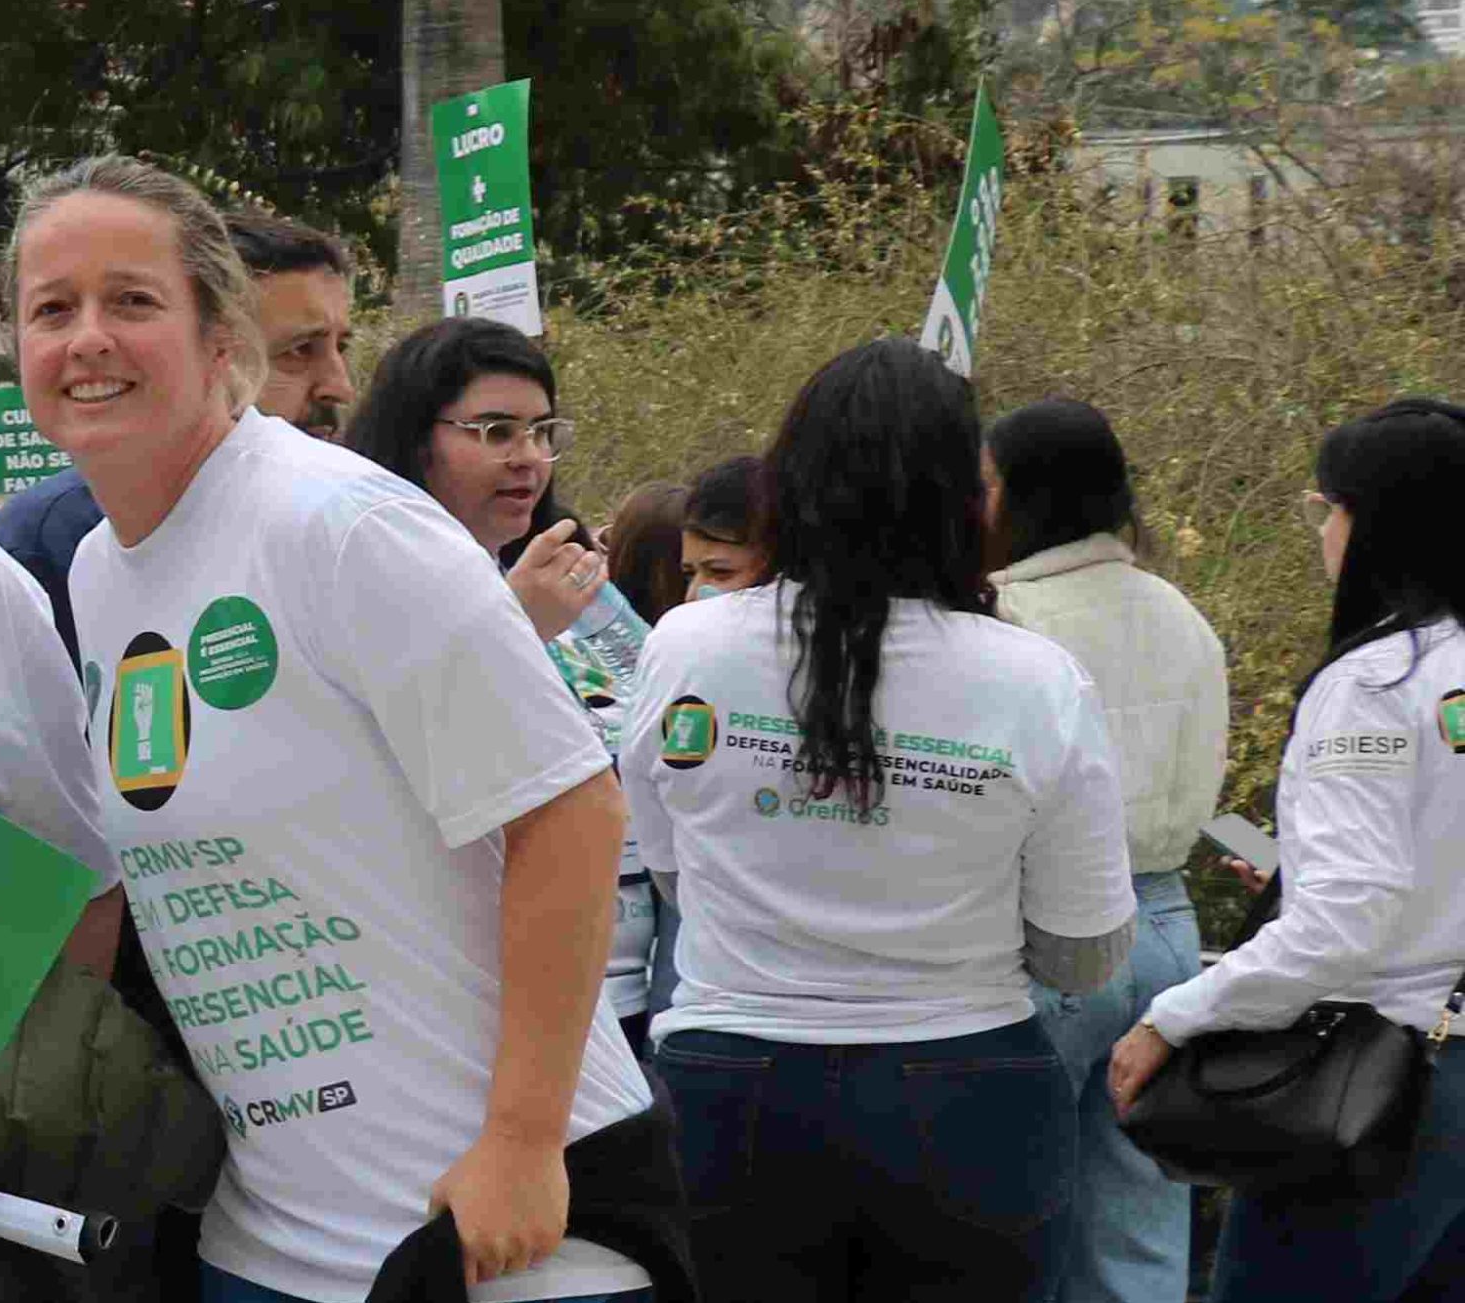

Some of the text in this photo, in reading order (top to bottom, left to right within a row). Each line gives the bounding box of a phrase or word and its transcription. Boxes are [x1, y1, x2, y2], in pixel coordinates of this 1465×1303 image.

[452, 123, 504, 158] LUCRO
[502, 208, 520, 224] DE
[6, 450, 72, 470] NÃO SE
[726, 735, 792, 754] DEFESA
[894, 732, 1016, 768] ESSENCIAL
[892, 774, 917, 788] EM
[923, 777, 985, 796] SAÚDE
[120, 837, 245, 880] CRMV-SP
[164, 878, 301, 925] DEFESA
[163, 912, 361, 978] FORMAÇÃO
[235, 1009, 374, 1070] SAÚDE
[247, 1090, 314, 1127] CRMV
